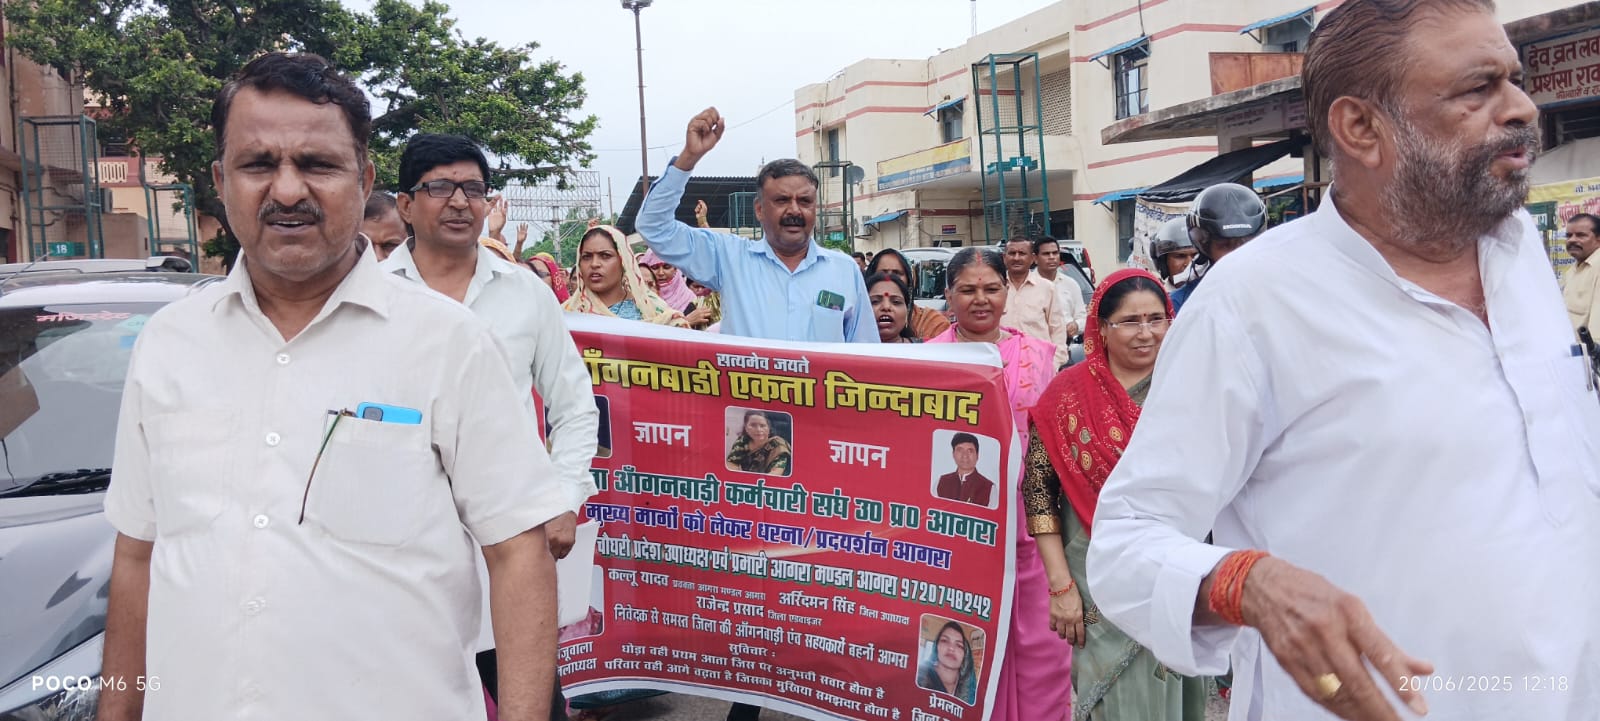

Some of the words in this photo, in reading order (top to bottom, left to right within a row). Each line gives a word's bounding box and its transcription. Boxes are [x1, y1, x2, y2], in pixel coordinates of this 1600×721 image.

[1530, 67, 1573, 95] प्रशंसा
[56, 244, 67, 254] 18
[716, 352, 769, 370] सत्यमेव
[773, 356, 809, 373] जयते
[728, 371, 817, 408] एकता
[824, 371, 982, 425] जिन्दाबाद
[632, 421, 692, 447] ज्ञापन
[828, 440, 890, 469] ज्ञापन
[585, 502, 630, 527] मुख्य
[682, 510, 706, 533] को
[710, 511, 753, 539] लेकर
[893, 540, 952, 570] आगरा
[725, 479, 808, 514] कर्मचारी
[927, 508, 998, 547] आगरा
[608, 568, 638, 587] कल्लू
[640, 571, 670, 586] यादव
[832, 596, 856, 614] सिंह
[859, 605, 878, 619] जिला
[633, 536, 662, 561] प्रदेश
[664, 544, 709, 569] उपाध्यक्ष
[731, 551, 767, 576] प्रभारी
[770, 559, 812, 582] आगरा
[814, 564, 854, 588] मण्डल
[857, 570, 899, 597] आगरा
[901, 578, 992, 619] 9720748242
[696, 595, 730, 613] राजेन्द्र
[733, 602, 764, 617] प्रसाद
[767, 609, 786, 622] जिला
[614, 604, 648, 623] निवेदक
[650, 607, 659, 624] से
[662, 612, 689, 628] समस्त
[692, 613, 717, 632] जिला
[719, 619, 732, 635] की
[849, 642, 874, 661] बहनों
[878, 649, 908, 668] आगरा
[728, 643, 768, 656] सुविचार
[604, 658, 640, 670] परिवार
[667, 664, 690, 675] आगे
[724, 669, 732, 681] है
[736, 672, 772, 687] जिसका
[776, 679, 812, 697] मुखिया
[864, 702, 888, 717] होता
[891, 708, 901, 720] है
[672, 649, 697, 661] प्रथम
[701, 655, 727, 666] आता
[731, 656, 755, 670] जिस
[758, 662, 772, 672] पर
[819, 675, 846, 690] सवार
[849, 681, 873, 697] होता
[875, 687, 885, 699] है
[929, 693, 964, 719] प्रेमलता
